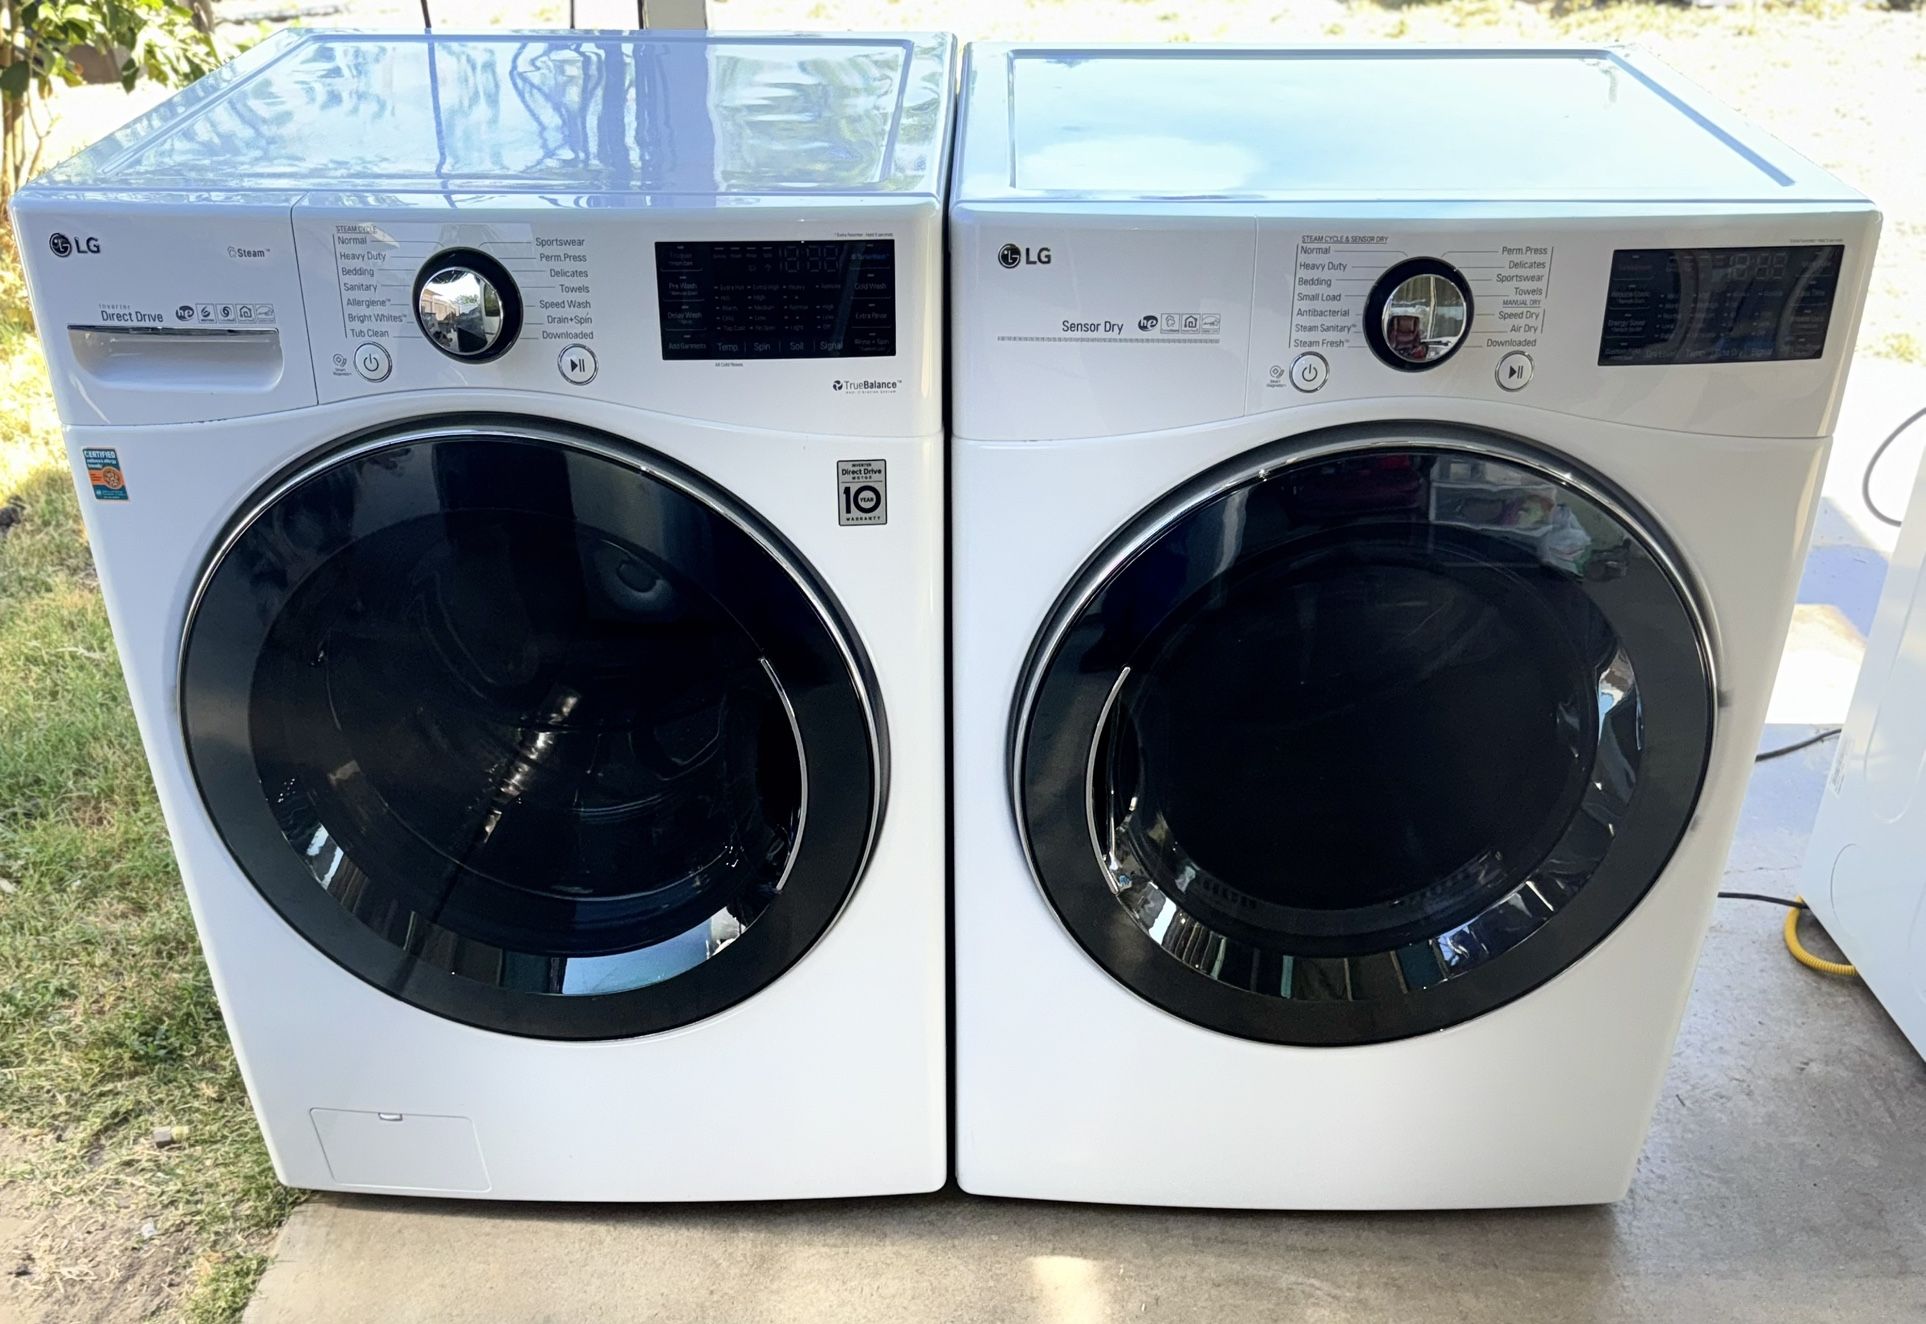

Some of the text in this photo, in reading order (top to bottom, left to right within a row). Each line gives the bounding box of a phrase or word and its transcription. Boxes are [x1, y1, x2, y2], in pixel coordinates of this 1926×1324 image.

[338, 236, 367, 245] Normal
[535, 237, 585, 248] Sportswear
[1351, 235, 1375, 243] SENSOR
[1376, 235, 1388, 243] DRY
[74, 236, 101, 254] LG
[1300, 245, 1331, 255] Normal
[340, 251, 386, 262] Heavy Duty
[1025, 247, 1052, 265] LG
[1299, 261, 1348, 272] Heavy Duty
[1508, 260, 1546, 269] Delicates
[341, 266, 374, 277] Bedding
[549, 268, 589, 278] Delicates
[1298, 277, 1332, 288] Bedding
[1496, 273, 1544, 284] Sportswear
[344, 282, 378, 293] Sanitary
[559, 284, 590, 293] Towels
[1514, 286, 1543, 296] Towels
[1297, 292, 1342, 302] Small Load
[540, 299, 591, 310] Speed Wash
[101, 310, 163, 323] Direct Drive
[1296, 308, 1350, 317] Antibacterial
[1498, 310, 1540, 321] Speed Dry
[348, 313, 372, 324] Bright
[1062, 320, 1124, 335] Sensor Dry
[1295, 323, 1319, 332] Steam
[1510, 324, 1538, 334] Air Dry
[350, 328, 389, 338] Tub Clean
[542, 330, 594, 340] Downloaded
[718, 343, 738, 352] Temp
[753, 342, 771, 352] Spin
[790, 342, 804, 351] Soil
[819, 341, 843, 352] Signal
[1294, 338, 1320, 348] Steam
[1486, 338, 1537, 348] Downloaded
[841, 468, 862, 476] Direct
[843, 485, 882, 514] 10
